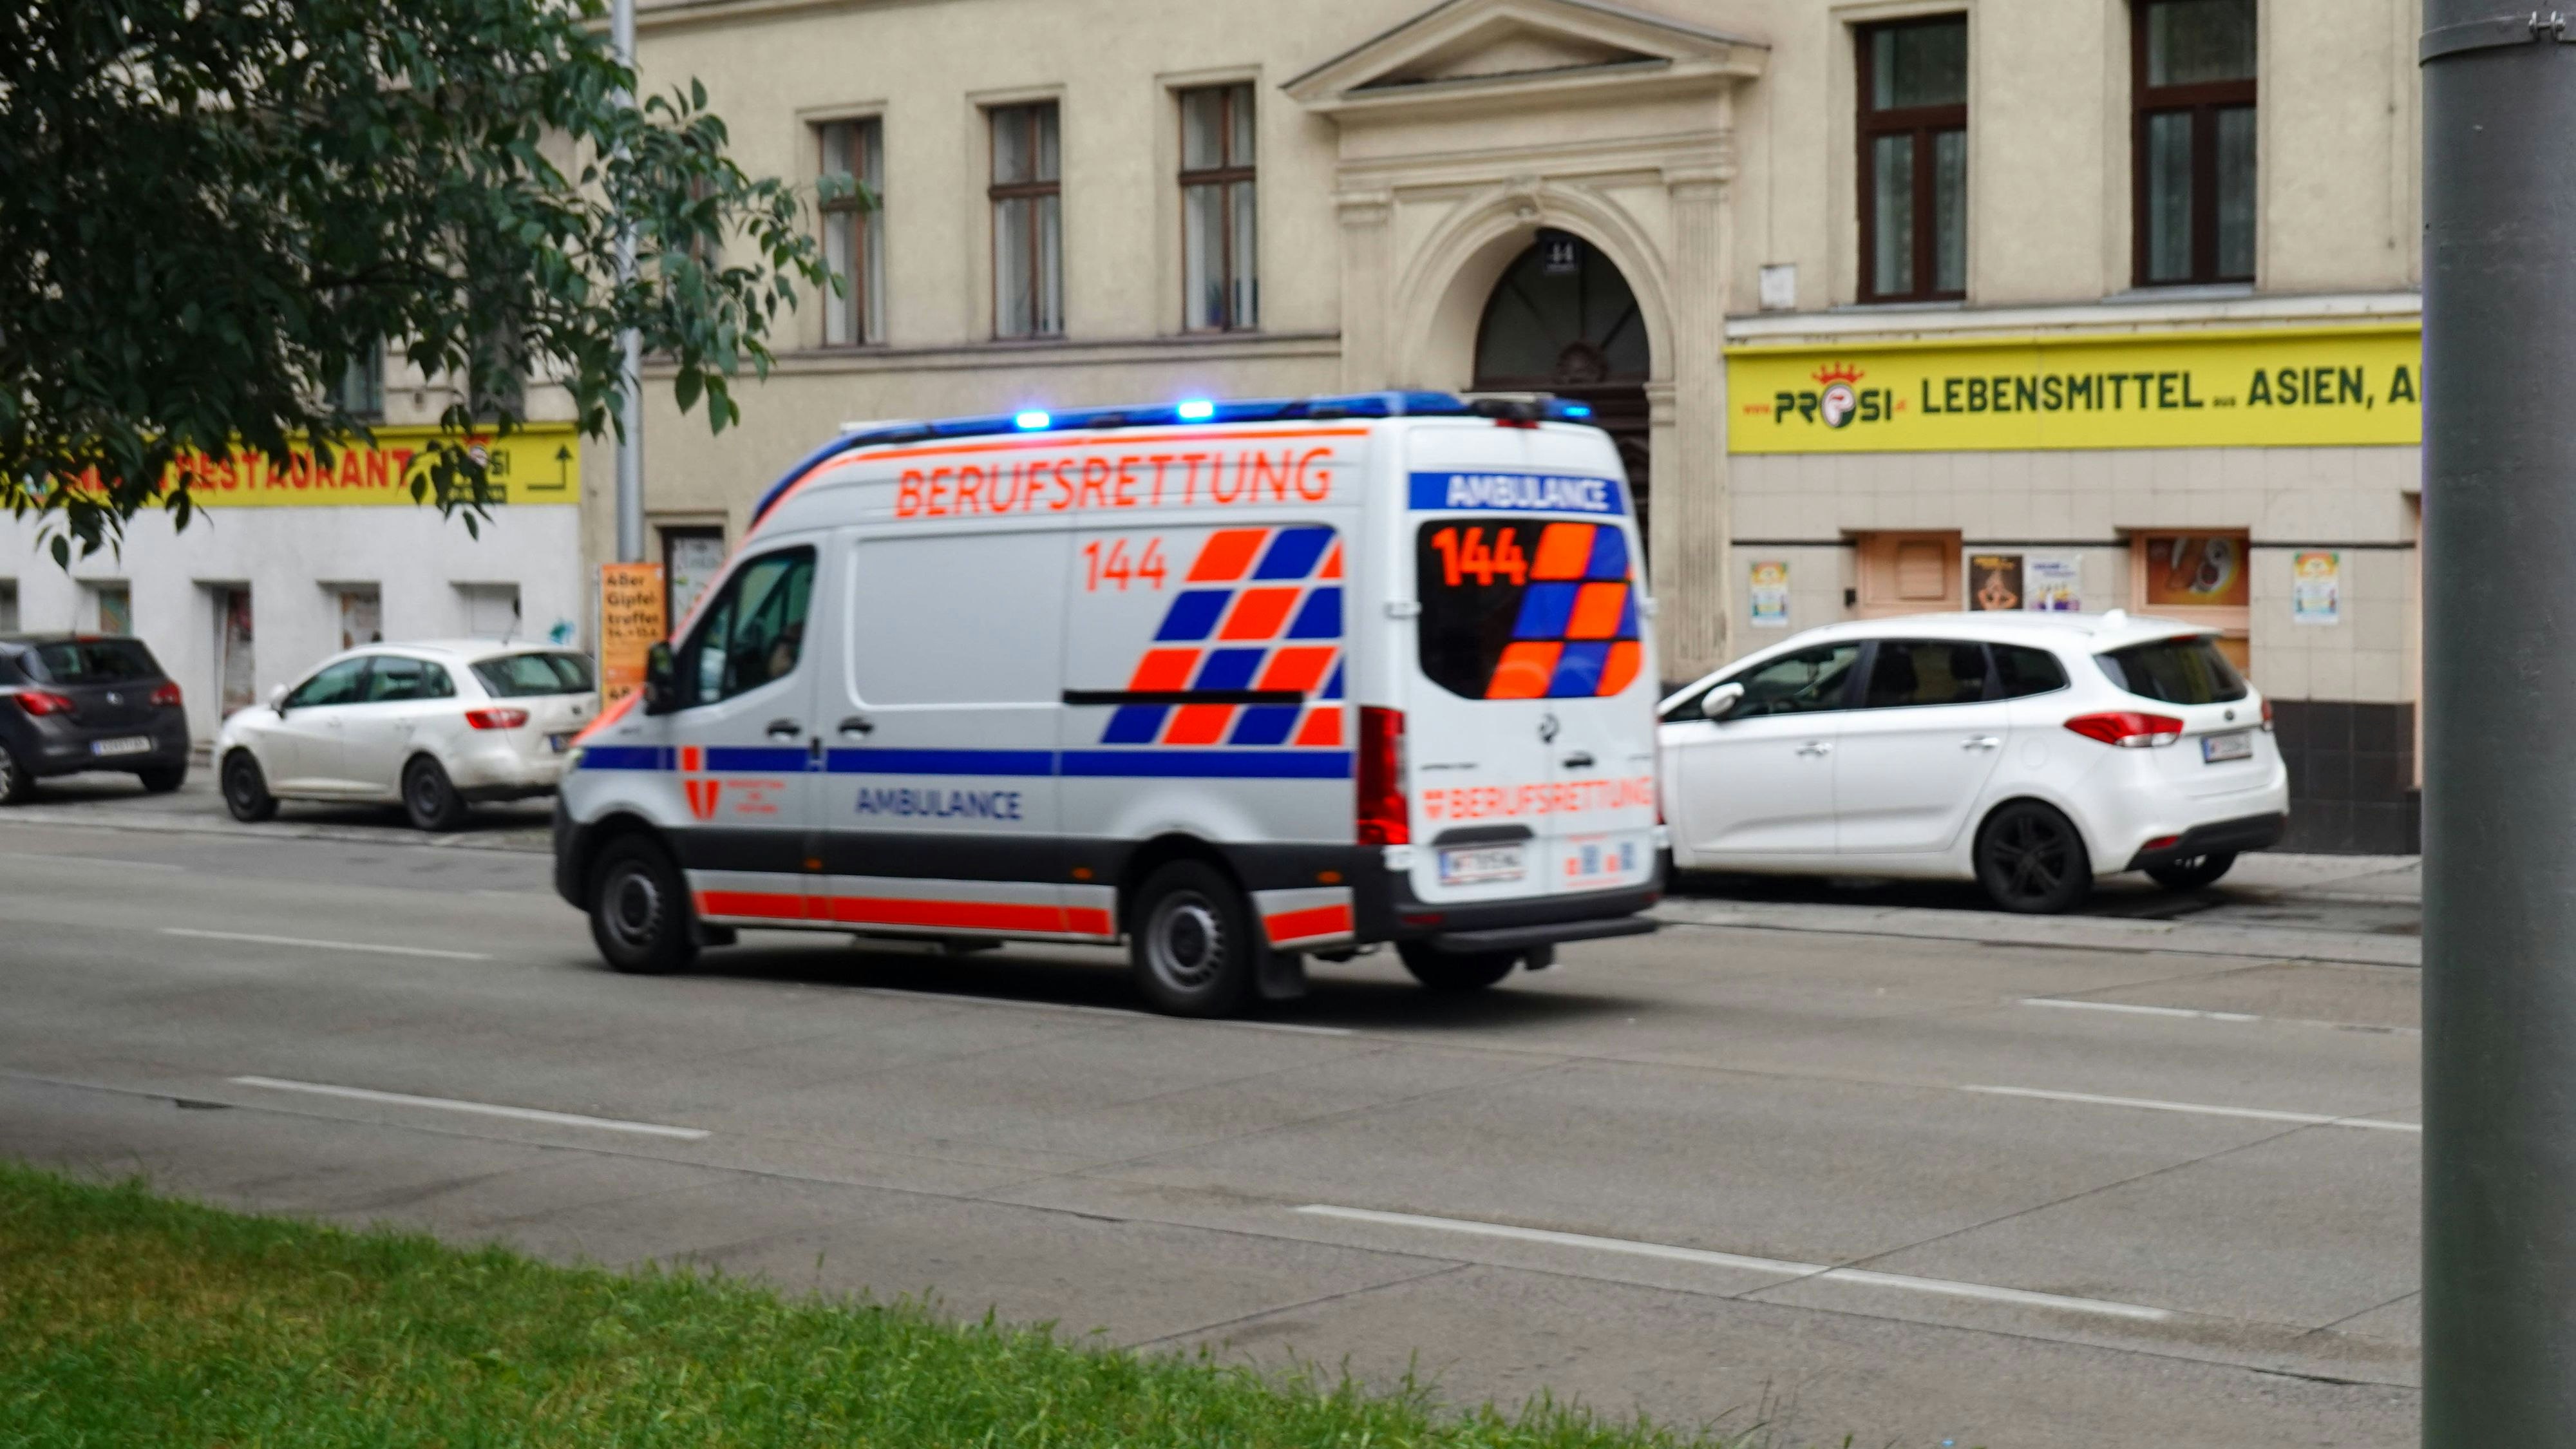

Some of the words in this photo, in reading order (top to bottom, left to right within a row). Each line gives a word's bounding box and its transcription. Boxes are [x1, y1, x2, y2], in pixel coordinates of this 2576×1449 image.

[1921, 371, 2204, 414] LEBENSMITTEL
[2246, 366, 2374, 411] ASIEN,
[2387, 364, 2422, 404] A
[893, 448, 1335, 518] BERUFSRETTUNG
[1446, 475, 1610, 511] AMBULANCE
[1083, 538, 1168, 592] 144
[1431, 527, 1528, 587] 144
[854, 787, 1023, 820] AMBULANCE
[1449, 775, 1653, 820] BERUFSRETTUNG
